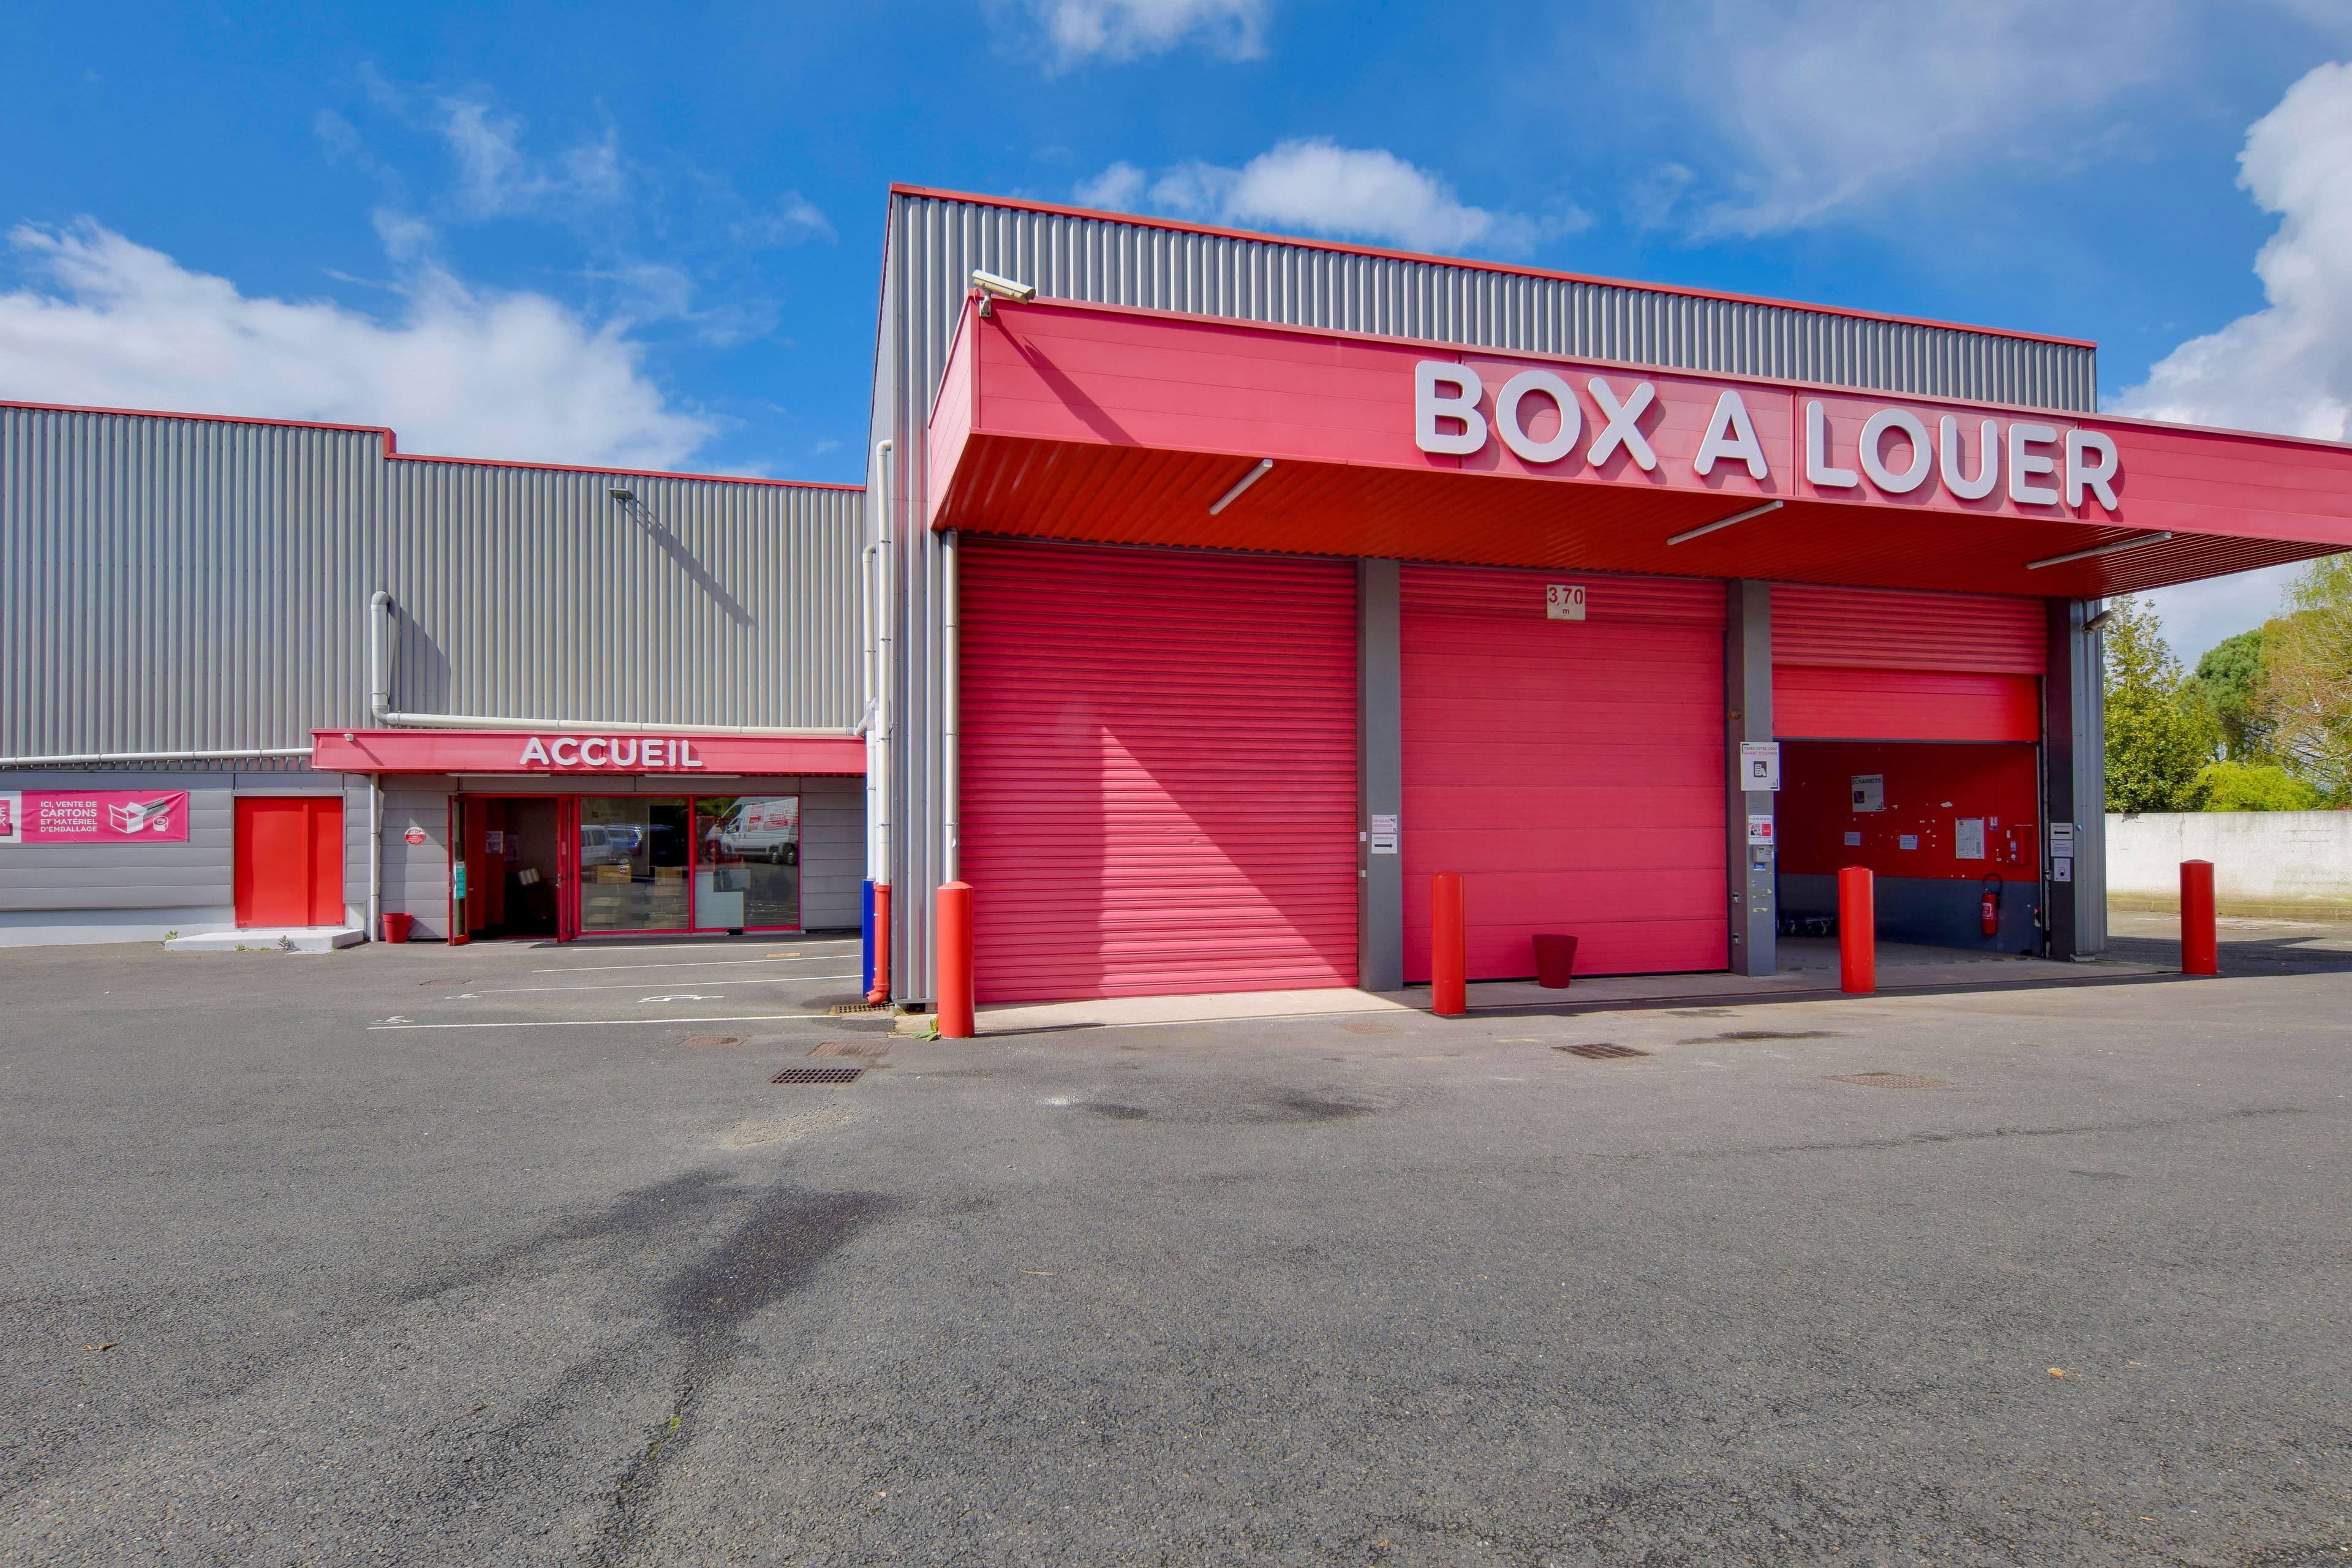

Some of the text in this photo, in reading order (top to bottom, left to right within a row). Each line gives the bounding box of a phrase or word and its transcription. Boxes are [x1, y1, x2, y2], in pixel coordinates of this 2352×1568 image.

[1415, 360, 2118, 511] BOX A LOUER
[1548, 587, 1583, 606] 3,70
[519, 737, 703, 766] ACCUEIL
